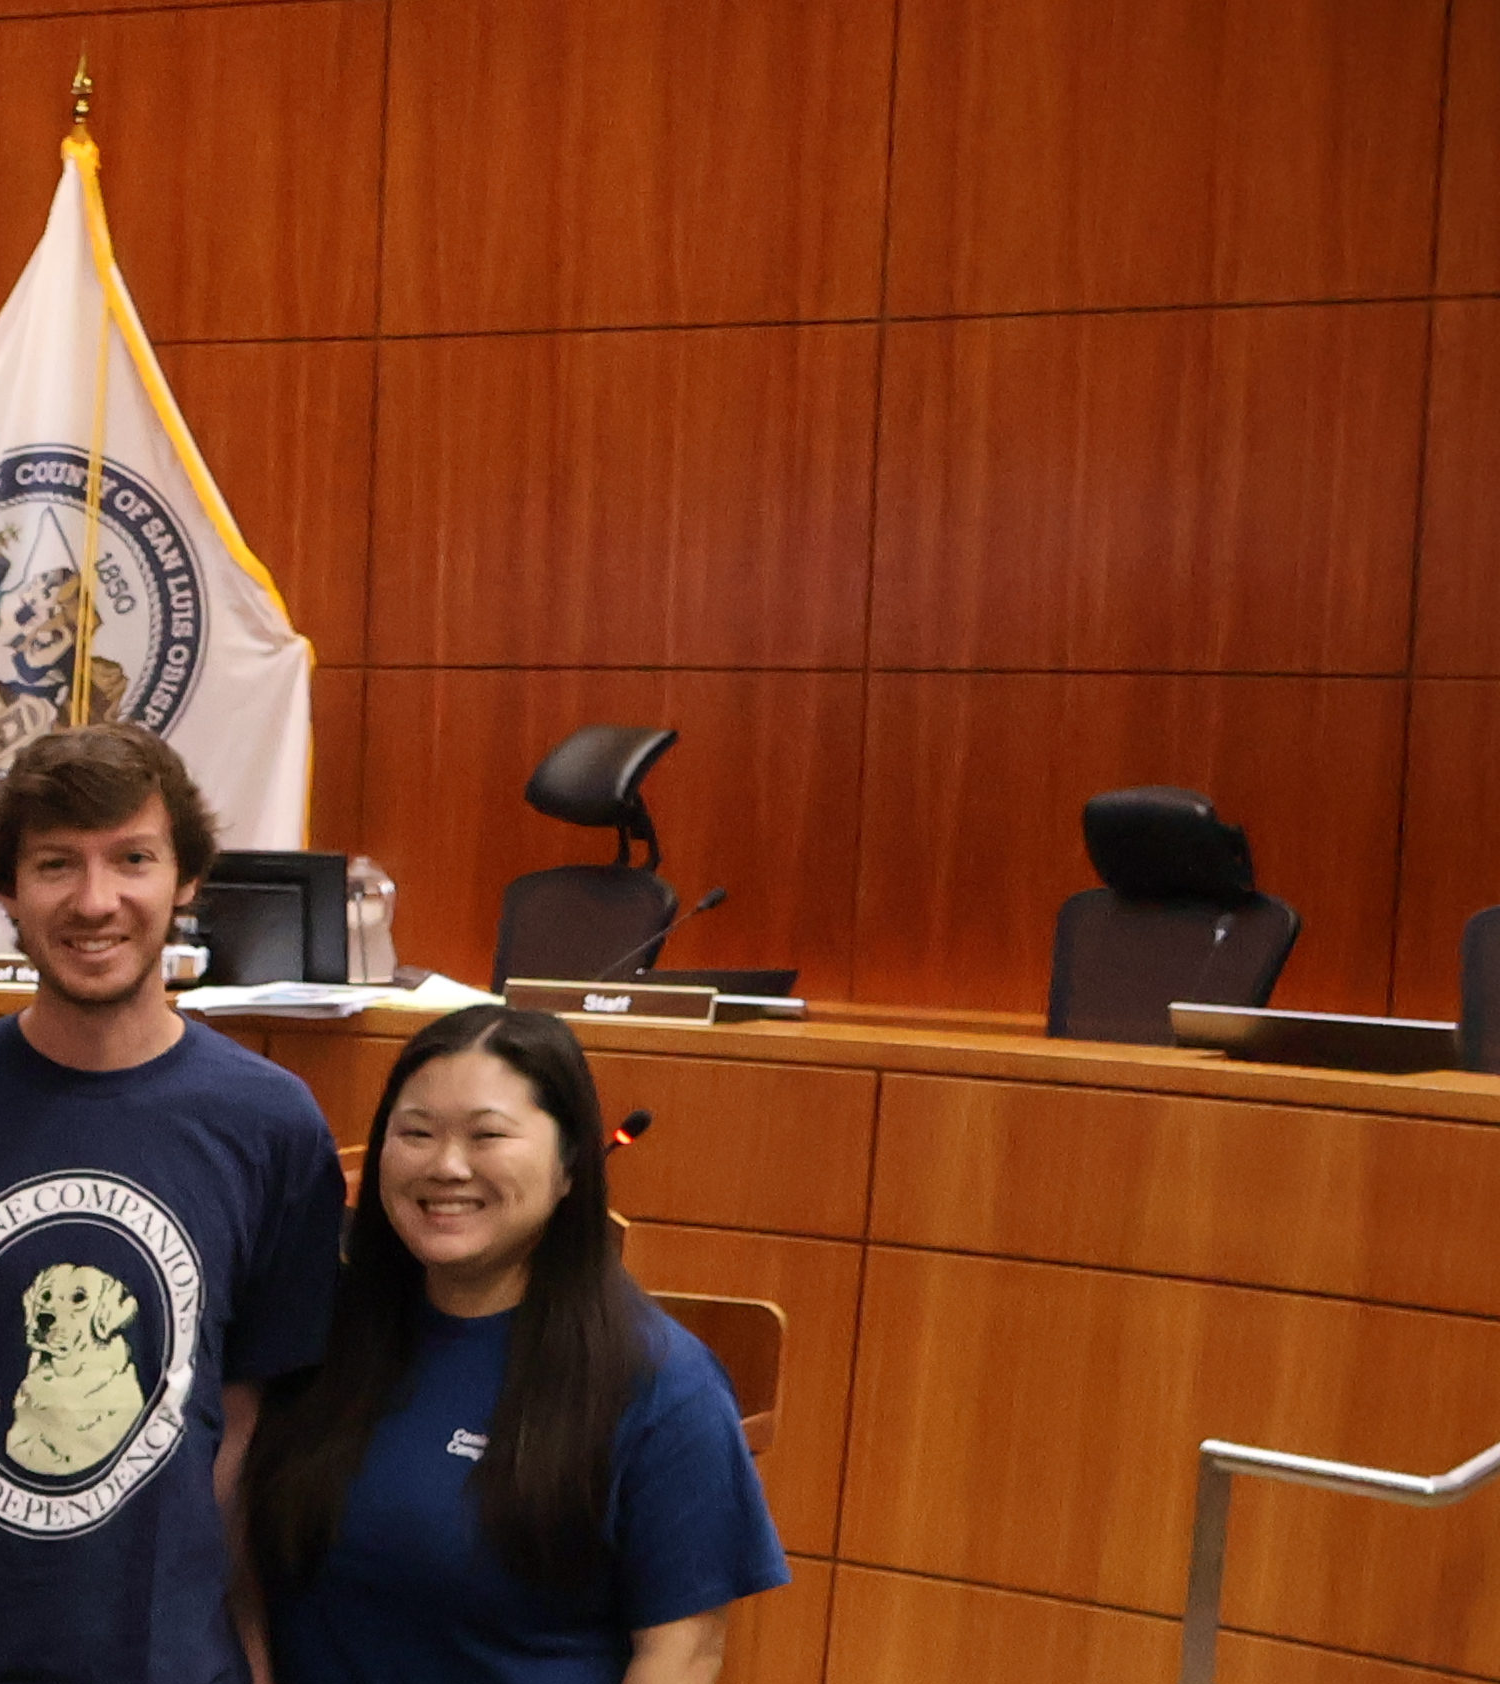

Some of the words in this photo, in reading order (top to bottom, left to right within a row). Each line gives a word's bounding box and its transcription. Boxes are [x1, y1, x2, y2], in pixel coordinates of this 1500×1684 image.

[15, 460, 120, 500] COUNY
[113, 488, 152, 522] OF
[140, 520, 186, 572] SAN
[94, 551, 138, 615] 1850
[168, 571, 196, 640] LUIS
[140, 646, 193, 732] OBISP
[582, 993, 632, 1013] Staff
[33, 1181, 201, 1335] COMPANIONS
